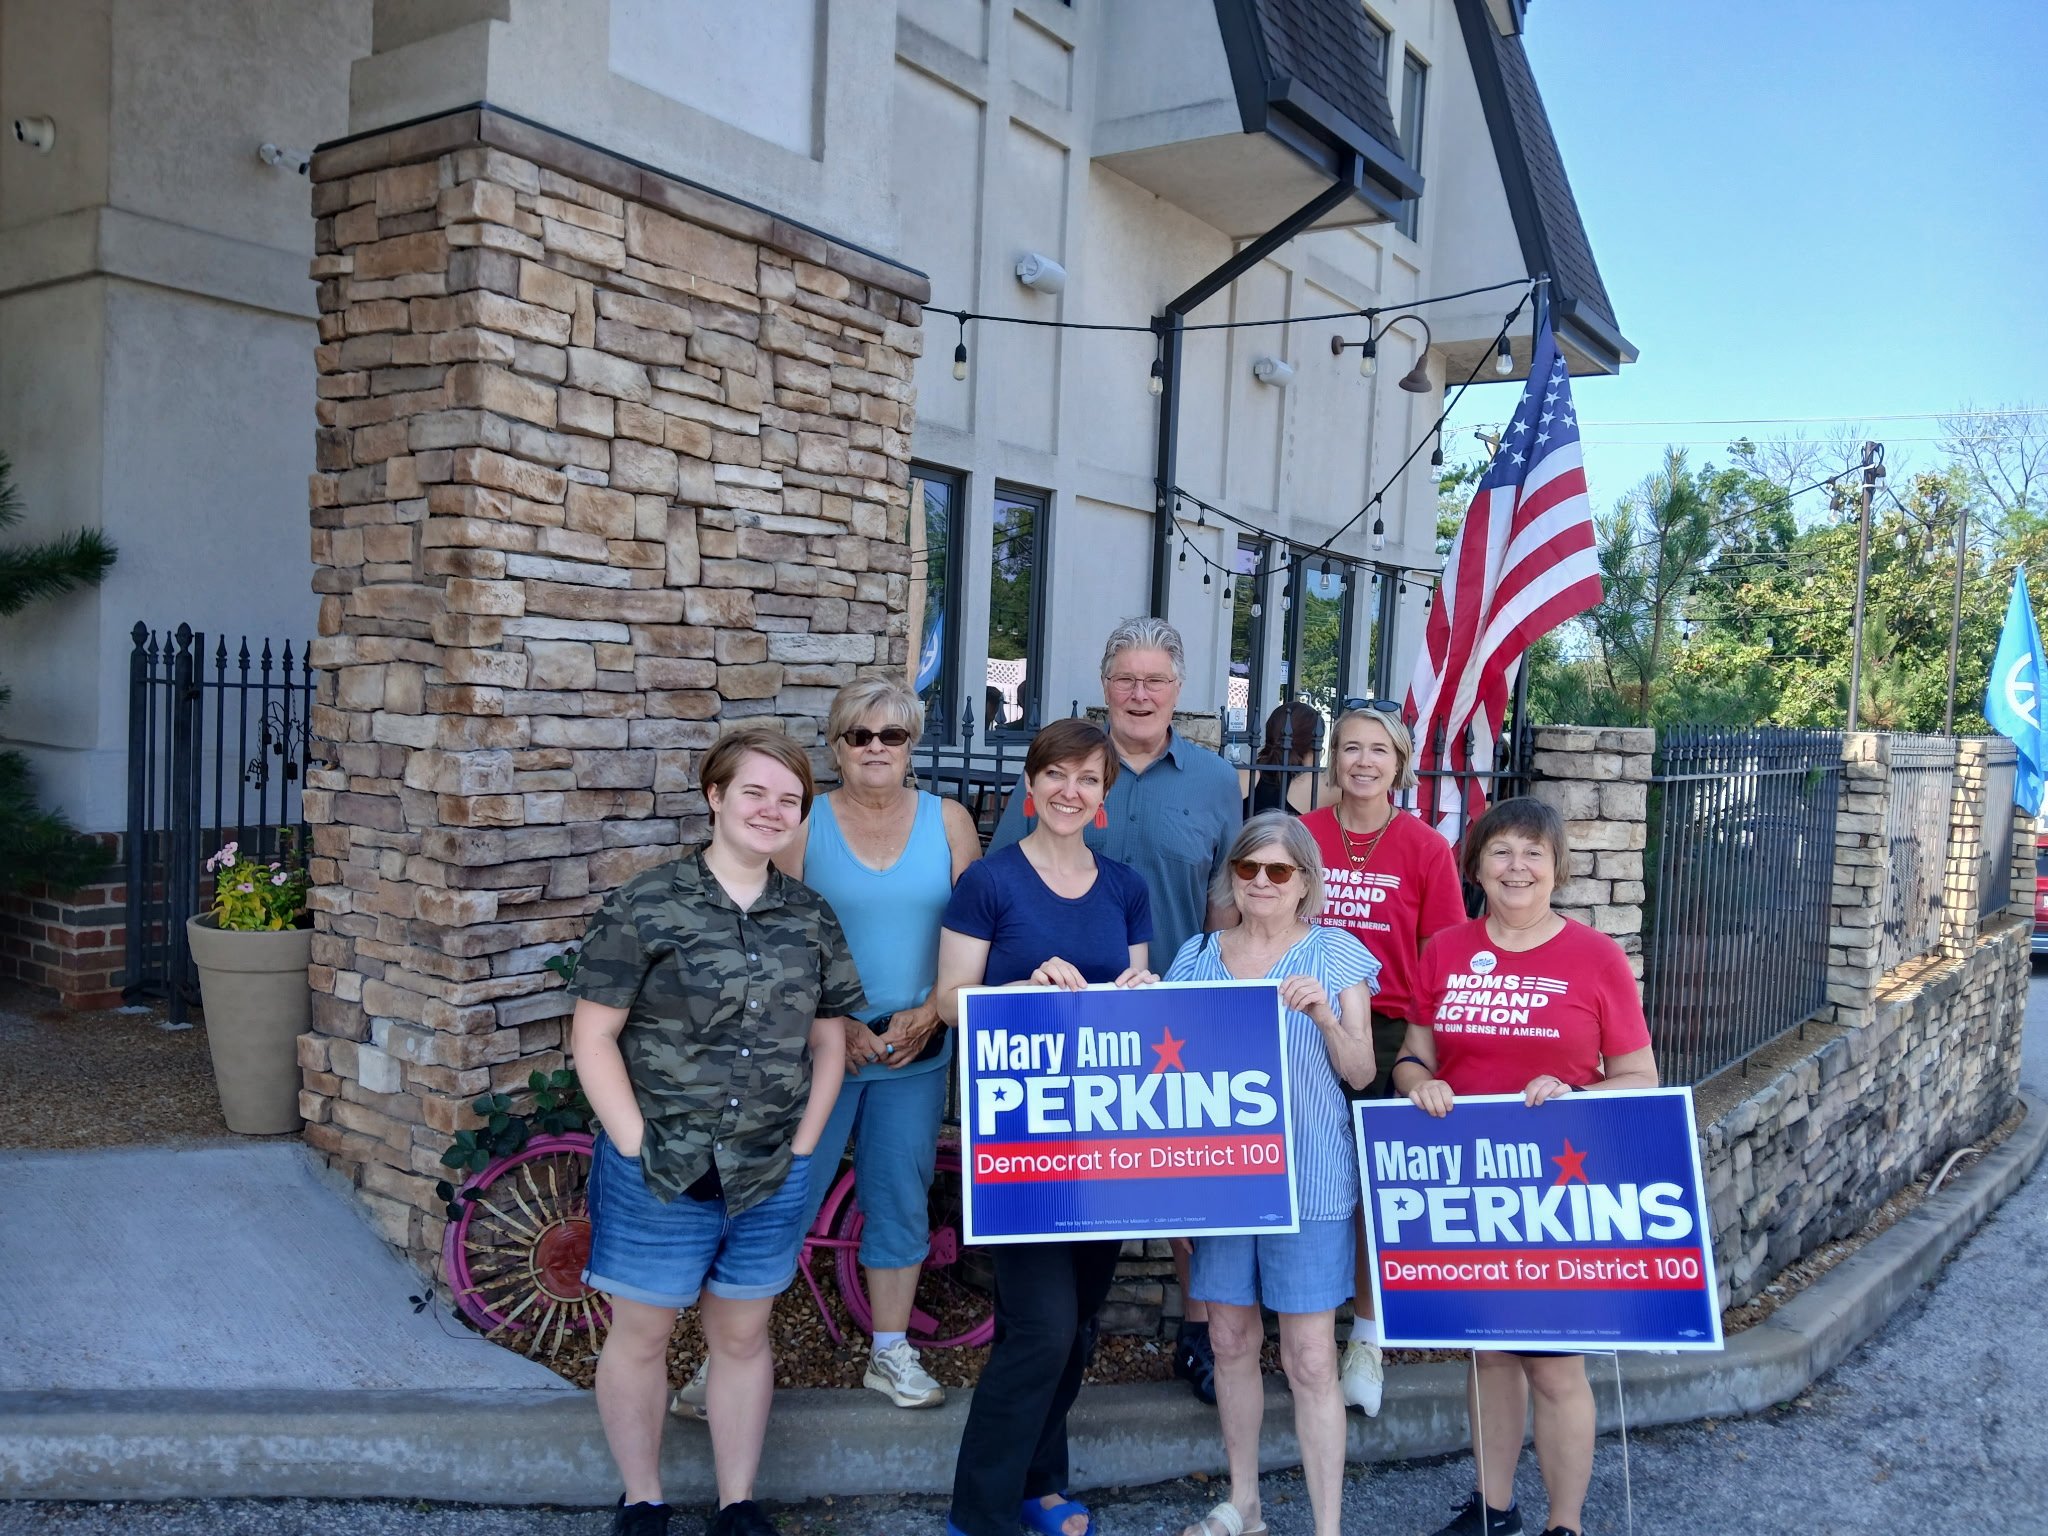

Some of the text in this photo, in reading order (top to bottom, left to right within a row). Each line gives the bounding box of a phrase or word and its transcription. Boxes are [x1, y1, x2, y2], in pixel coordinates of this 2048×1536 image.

[1321, 867, 1363, 885] OMS
[1324, 883, 1387, 903] MAND
[1323, 900, 1371, 919] TION
[1323, 917, 1347, 928] SENSE
[1347, 919, 1356, 928] IN
[1356, 920, 1391, 932] AMERICA
[1446, 974, 1521, 990] MOMS
[1442, 990, 1549, 1008] DEMAND
[1435, 1005, 1530, 1025] ACTION
[1445, 1023, 1463, 1033] GUN
[1465, 1024, 1497, 1035] SENSE
[1499, 1026, 1510, 1036] IN
[1512, 1027, 1560, 1039] AMERICA
[975, 1026, 1142, 1075] Mary Ann
[975, 1070, 1279, 1136] PERKINS
[977, 1143, 1281, 1175] Democrat for District 100
[1373, 1137, 1543, 1186] Mary Ann
[1376, 1181, 1694, 1244] PERKINS
[1385, 1257, 1699, 1281] Democrat for District 100
